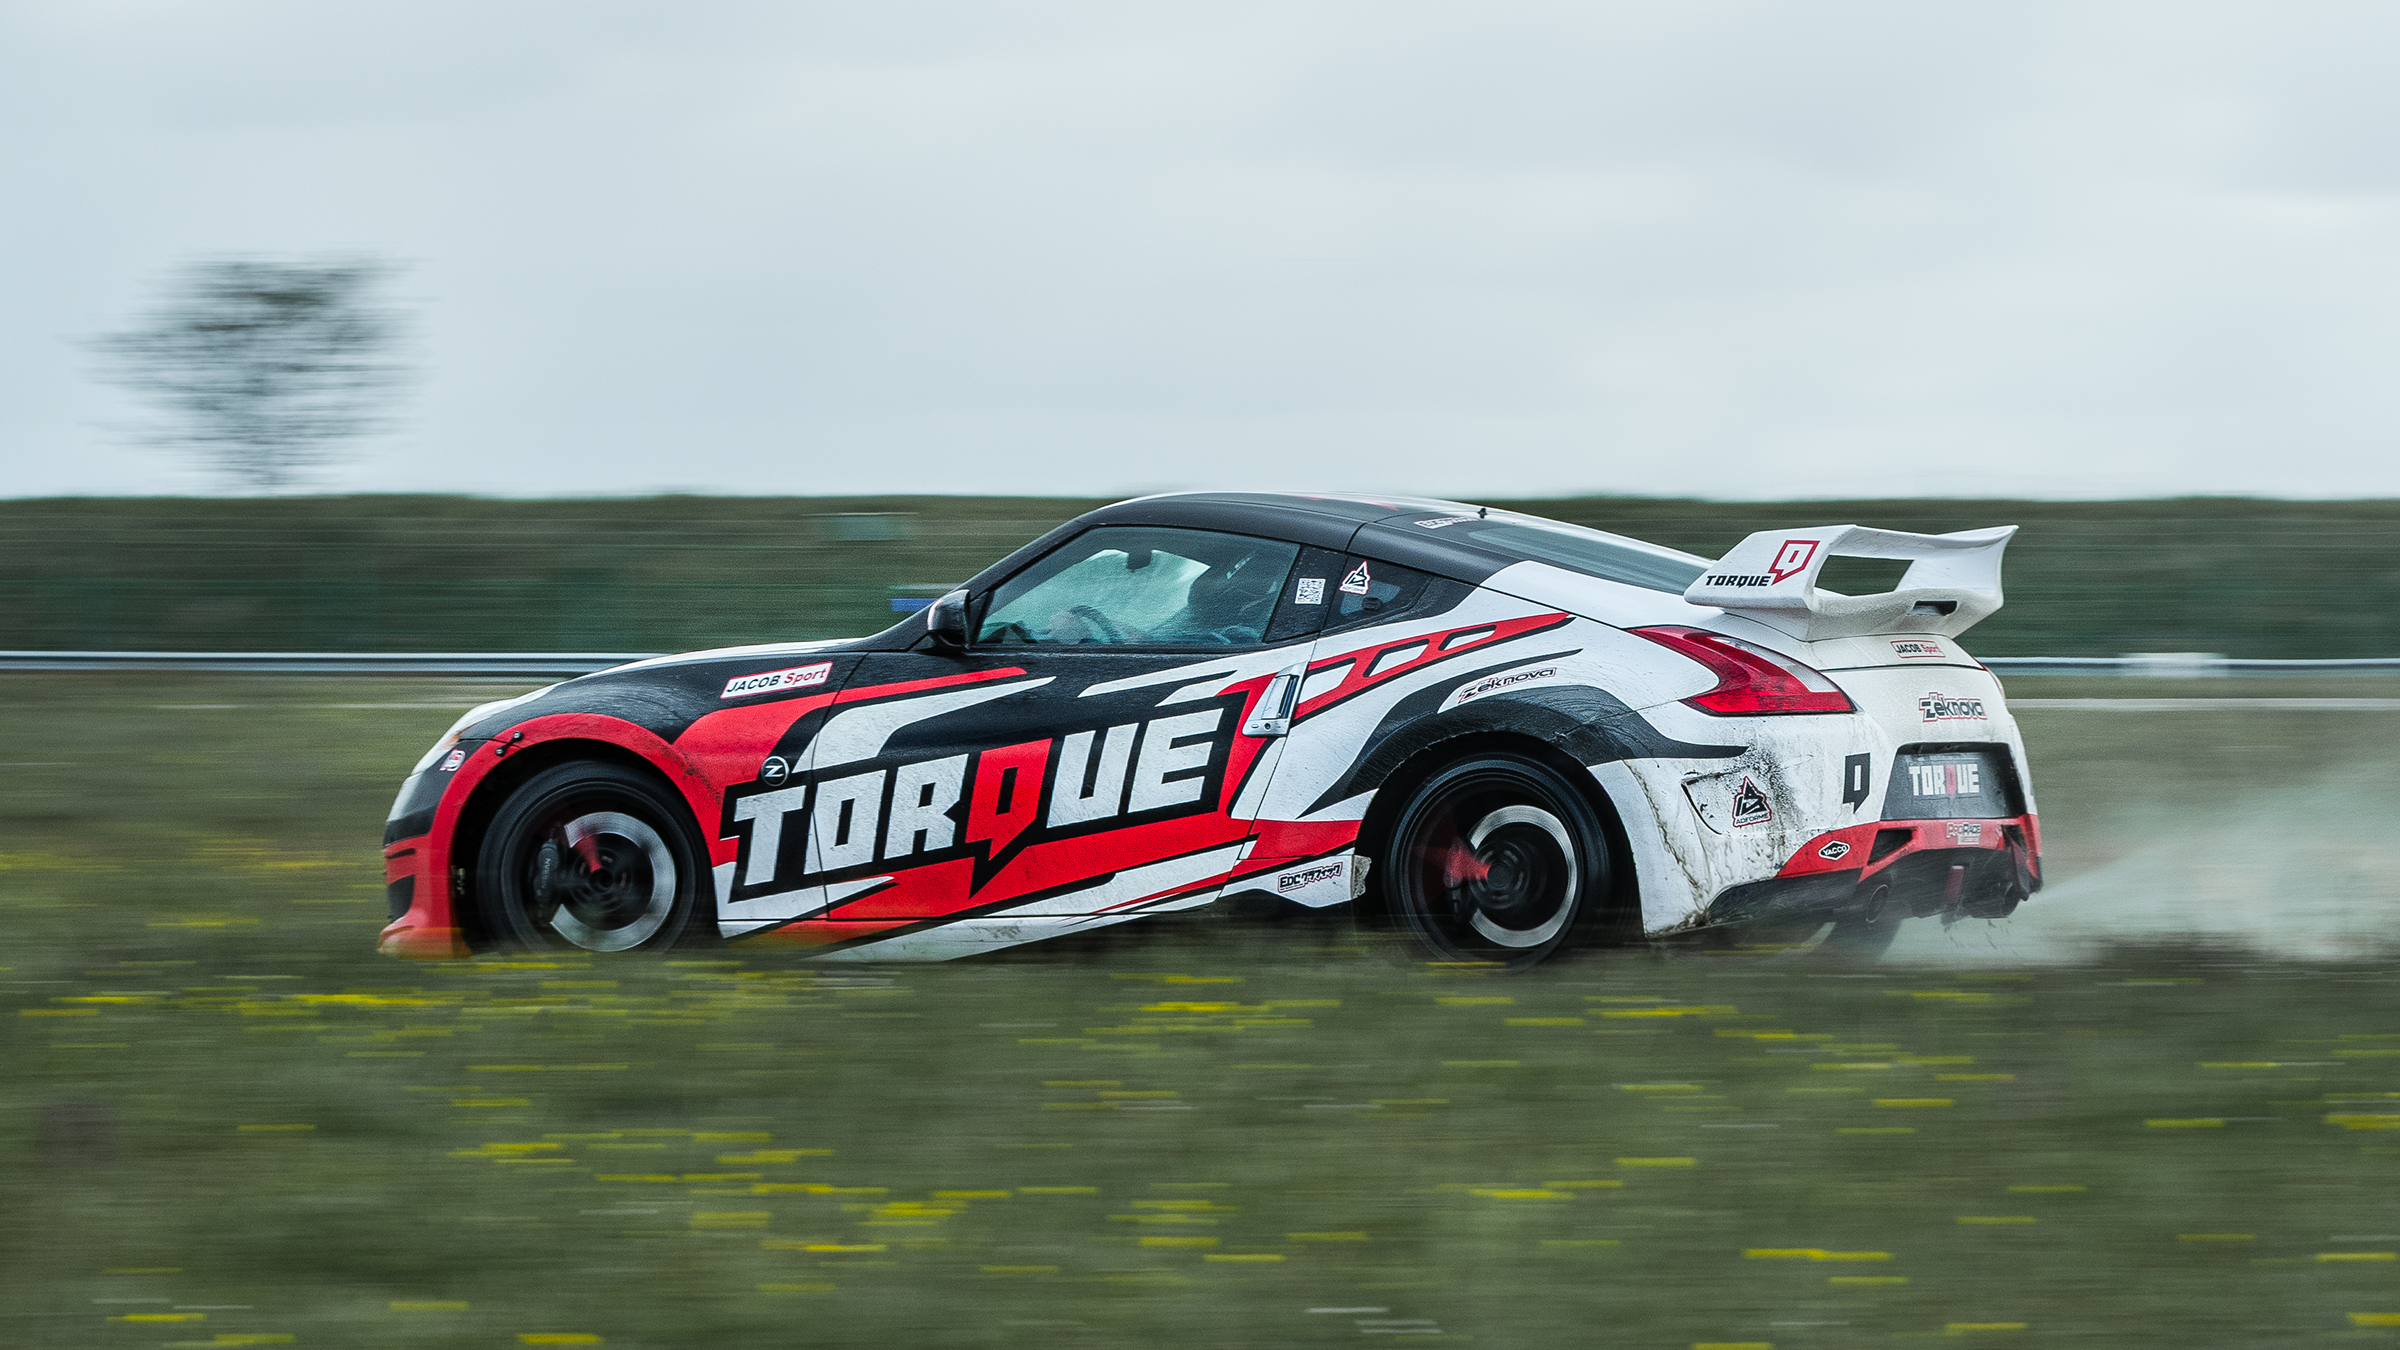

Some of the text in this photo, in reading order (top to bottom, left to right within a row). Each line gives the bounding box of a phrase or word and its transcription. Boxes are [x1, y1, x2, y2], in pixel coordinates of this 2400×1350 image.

[1706, 575, 1771, 588] TORQUE
[1896, 644, 1922, 653] JACOB
[727, 668, 826, 692] JACOB Sport
[1463, 669, 1554, 699] Zeknova
[1921, 697, 1985, 718] Zeknova
[1909, 764, 1979, 799] TORQUE
[734, 707, 1224, 887] TORQUE
[1823, 845, 1847, 855] YACCO
